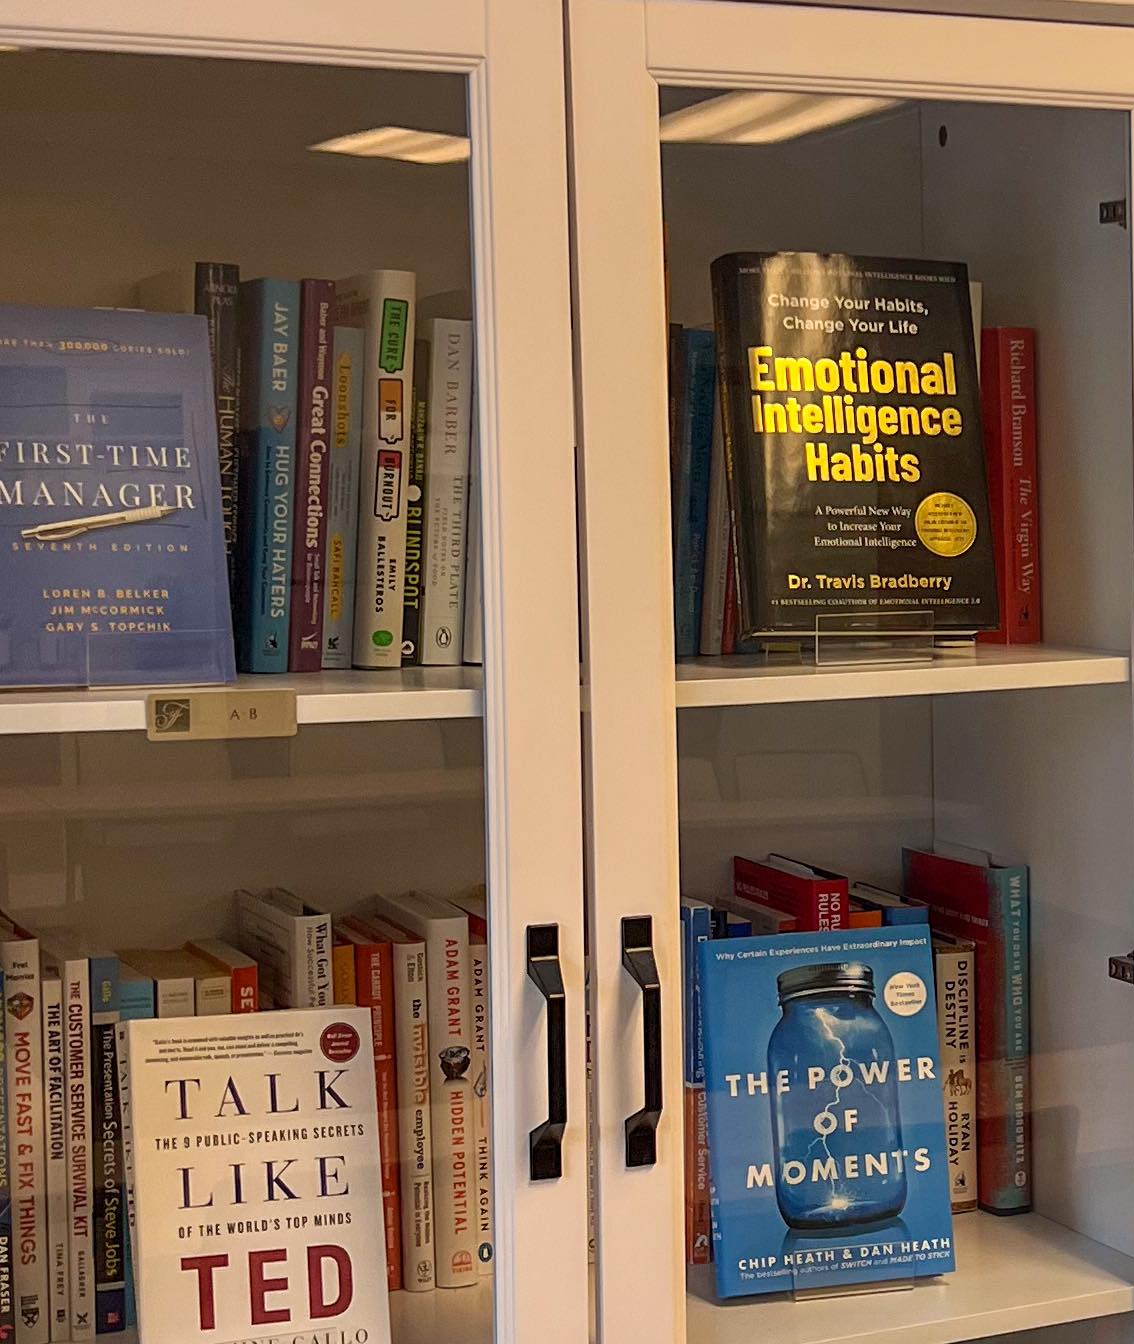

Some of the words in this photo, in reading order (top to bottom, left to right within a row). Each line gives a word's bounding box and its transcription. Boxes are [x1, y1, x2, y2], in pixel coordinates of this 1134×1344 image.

[275, 303, 289, 337] JAY
[390, 306, 402, 326] THE
[768, 294, 829, 310] Change
[835, 296, 870, 310] Your
[875, 297, 929, 315] Habits,
[385, 329, 401, 361] CURE
[783, 317, 845, 333] Change
[849, 319, 885, 333] Your
[889, 320, 918, 335] Life
[272, 343, 288, 392] BAER
[748, 345, 955, 395] Emotional
[1009, 339, 1026, 396] Richard
[73, 413, 110, 425] THE
[311, 386, 329, 434] Great
[385, 399, 397, 421] FOR
[752, 395, 962, 444] Intelligence
[0, 441, 192, 468] FIRST-TIME
[1010, 401, 1028, 467] Branson
[275, 446, 290, 485] HUG
[805, 442, 921, 483] Habits
[0, 480, 196, 509] MANAGER
[306, 441, 327, 548] Connections
[381, 457, 396, 510] BURNOUT
[1019, 479, 1032, 505] The
[272, 492, 288, 544] YOUR
[815, 506, 823, 516] A
[825, 506, 867, 517] Powerful
[869, 506, 889, 516] New
[892, 506, 912, 518] Way
[828, 522, 838, 531] to
[840, 521, 877, 532] Increase
[879, 522, 902, 532] Your
[12, 542, 98, 552] SEVENTH
[111, 543, 189, 553] EDITION
[814, 536, 861, 547] Emotional
[864, 537, 917, 549] Intelligence
[1015, 511, 1032, 557] Virgin
[43, 589, 90, 599] LOREN
[115, 589, 169, 599] BELKER
[271, 548, 287, 618] HATERS
[376, 536, 386, 613] BALLESTEROS
[389, 558, 397, 591] EMILY
[788, 574, 812, 589] Dr.
[815, 574, 865, 589] Travis
[870, 574, 952, 592] Bradberry
[1016, 561, 1032, 594] Way
[46, 622, 84, 632] GARY
[108, 622, 172, 632] TOPCHIK
[50, 605, 77, 615] JIM
[446, 939, 459, 980] ADAM
[474, 959, 483, 997] ADAM
[70, 981, 81, 999] THE
[957, 960, 969, 1050] DISCIPLINE
[447, 987, 461, 1036] GRANT
[474, 1005, 485, 1052] GRANT
[945, 981, 956, 1049] DESTINY
[15, 1032, 31, 1085] MOVE
[68, 1004, 84, 1079] CUSTOMER
[164, 1069, 352, 1120] TALK
[725, 1069, 790, 1097] THE
[808, 1057, 936, 1088] POWER
[16, 1093, 32, 1136] FAST
[71, 1083, 86, 1143] SERVICE
[450, 1091, 464, 1142] HIDDEN
[813, 1110, 858, 1137] OF
[949, 1101, 959, 1166] HOLIDAY
[960, 1113, 969, 1152] RYAN
[18, 1141, 32, 1156] &
[155, 1138, 178, 1150] THE
[183, 1137, 191, 1149] 9
[196, 1129, 308, 1147] PUBLIC-SPEAKING
[313, 1124, 364, 1138] SECRETS
[18, 1162, 34, 1189] FIX
[72, 1145, 87, 1213] SURVIVAL
[479, 1138, 488, 1182] THINK
[746, 1148, 931, 1189] MOMENTS
[177, 1156, 349, 1210] LIKE
[452, 1147, 467, 1235] POTENTIAL
[74, 1216, 88, 1238] KIT
[178, 1226, 195, 1238] OF
[198, 1223, 222, 1236] THE
[227, 1219, 281, 1233] WORLD'S
[286, 1216, 309, 1229] TOP
[314, 1213, 352, 1227] MINDS
[479, 1187, 489, 1231] AGAIN
[18, 1196, 36, 1266] THINGS
[739, 1254, 775, 1270] CHIP
[785, 1249, 835, 1265] HEATH
[842, 1247, 852, 1260] &
[860, 1243, 893, 1257] DAN
[901, 1238, 951, 1252] HEATH
[180, 1244, 353, 1331] TED
